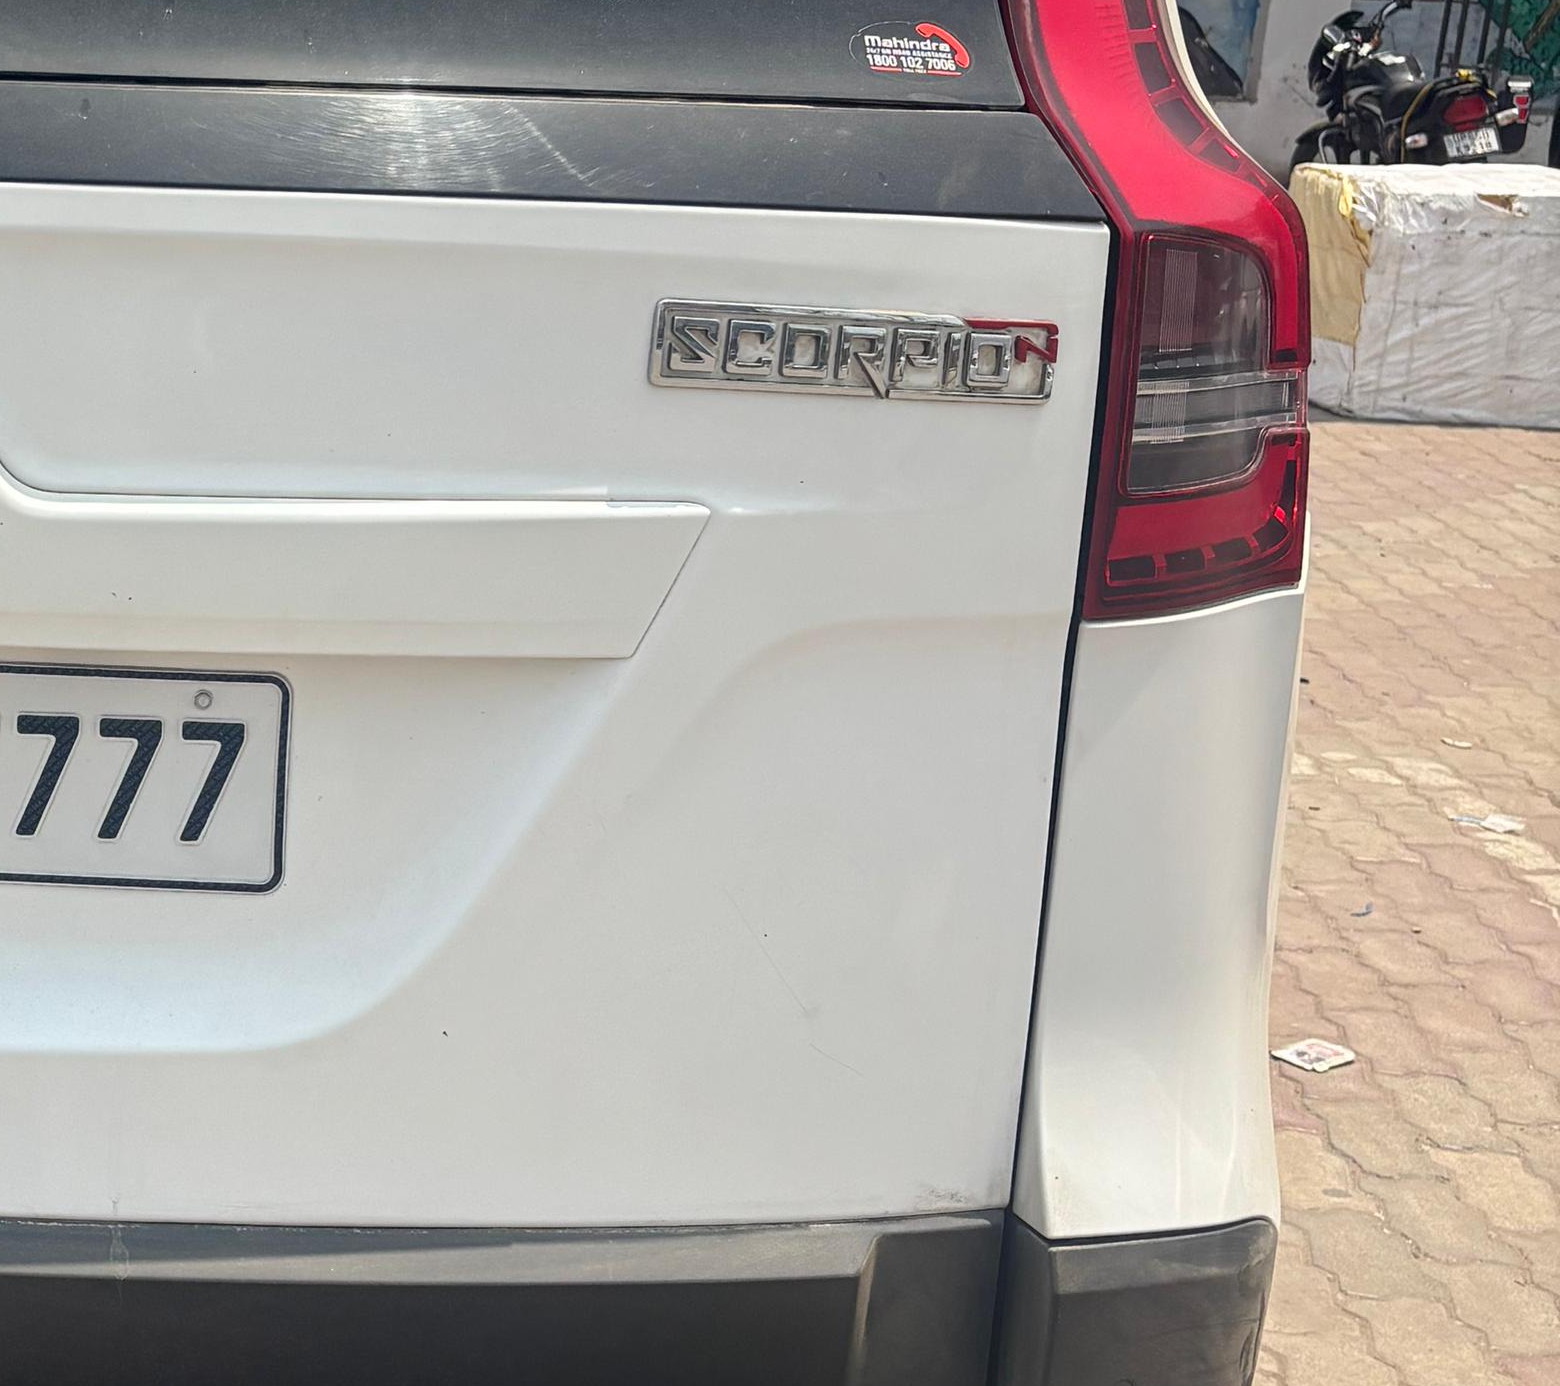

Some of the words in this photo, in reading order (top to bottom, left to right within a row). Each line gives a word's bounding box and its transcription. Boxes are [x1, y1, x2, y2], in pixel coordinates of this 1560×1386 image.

[866, 54, 898, 67] 1800
[900, 56, 924, 69] 102
[925, 58, 956, 71] 7006
